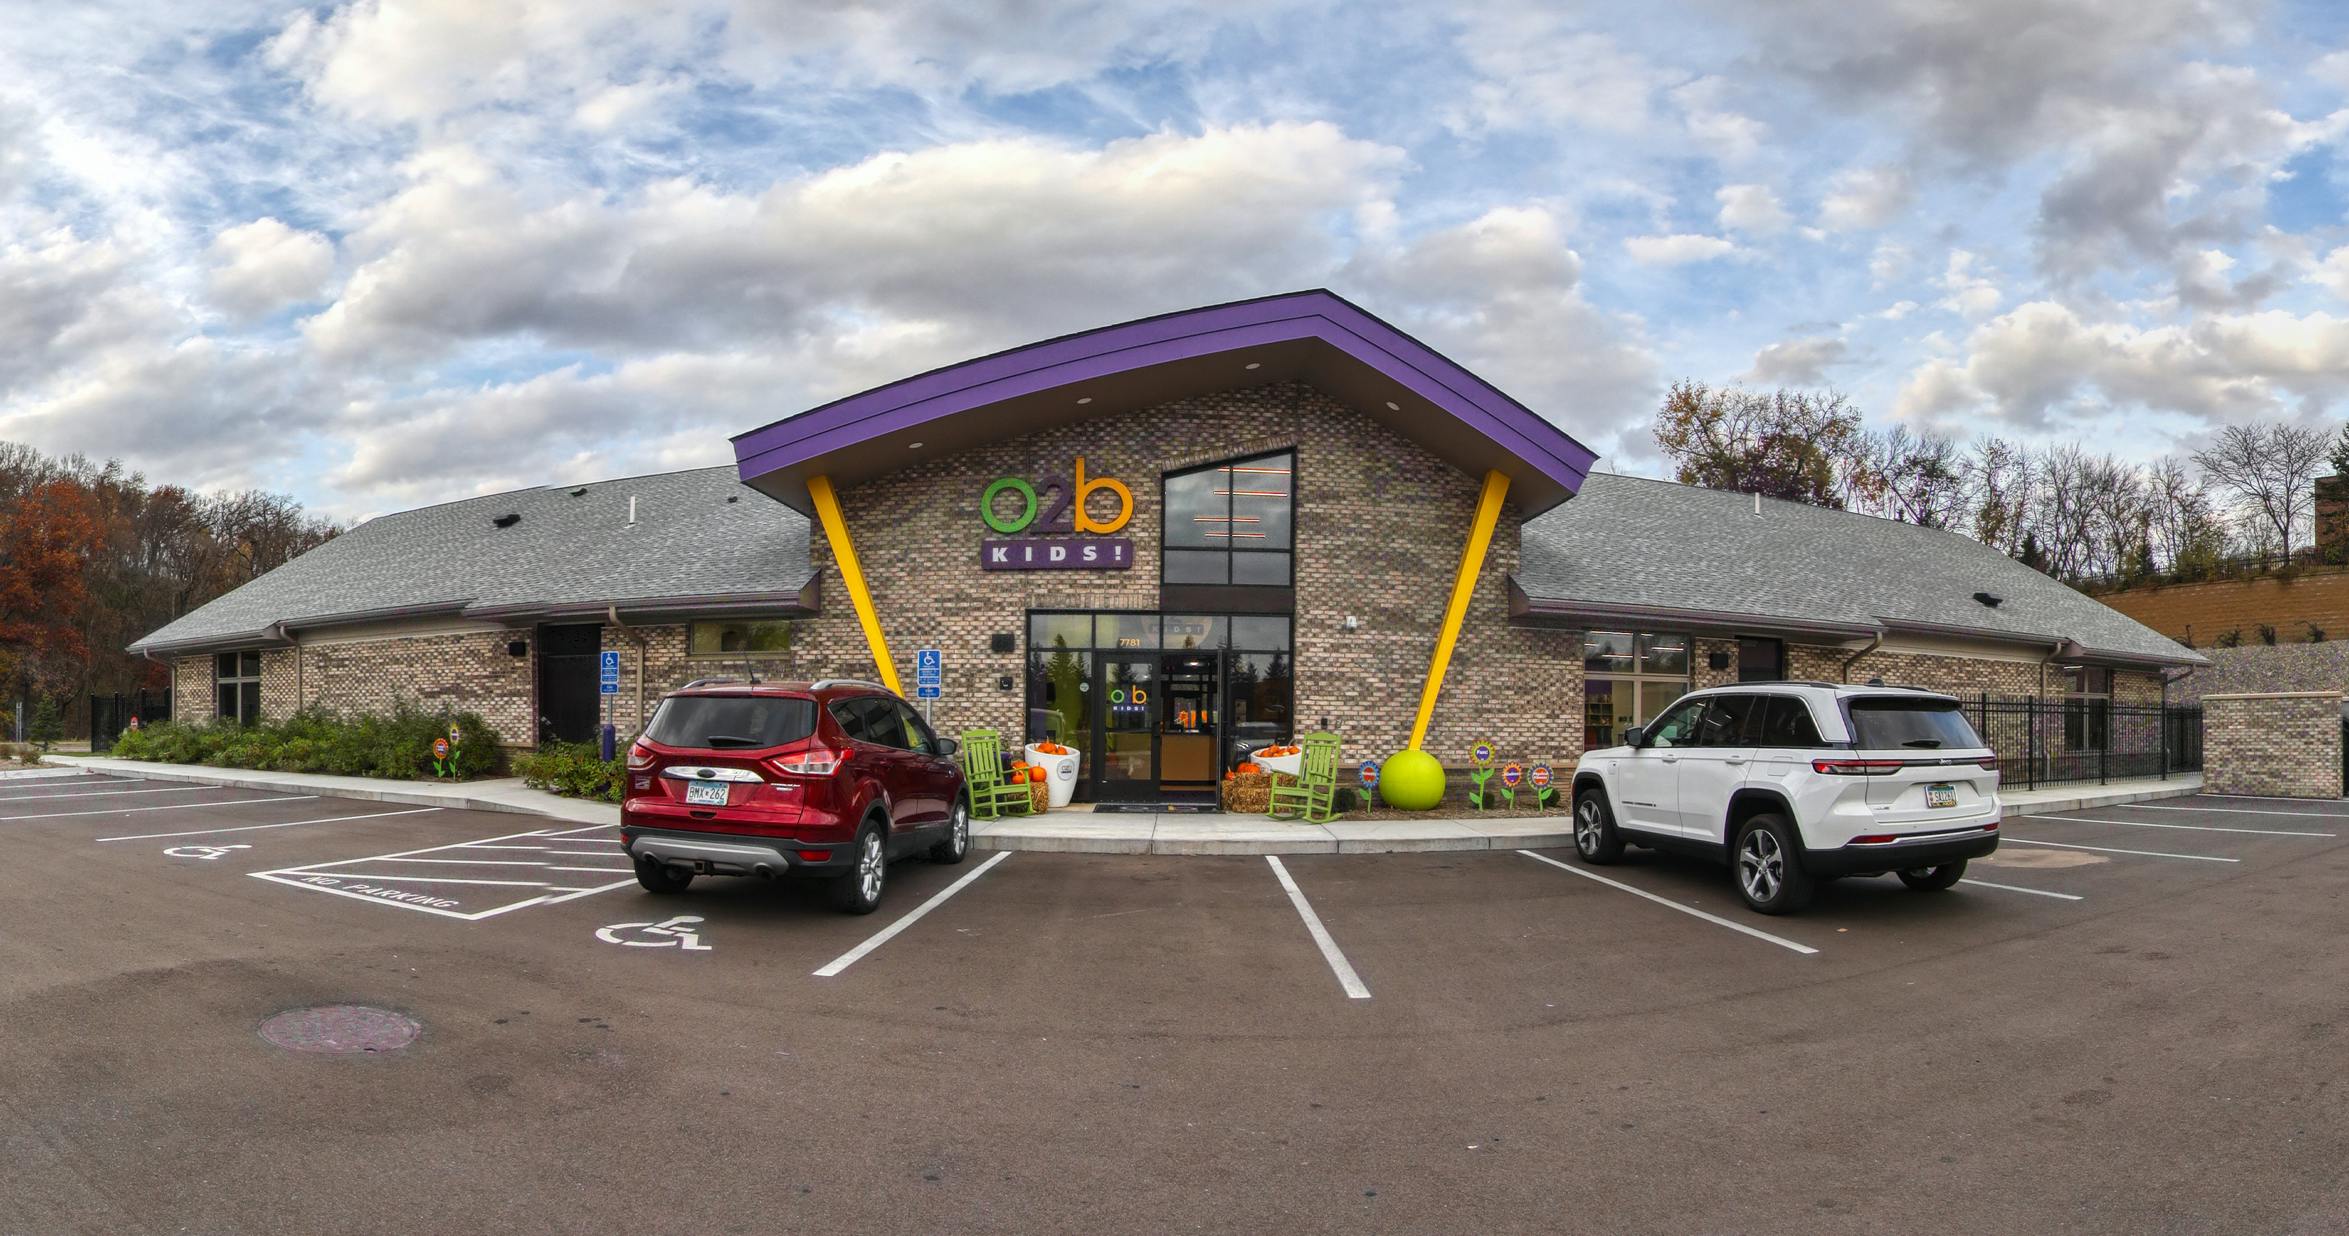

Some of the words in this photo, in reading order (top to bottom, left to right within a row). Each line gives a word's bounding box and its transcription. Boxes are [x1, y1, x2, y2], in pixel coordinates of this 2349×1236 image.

[981, 456, 1134, 534] o2b
[992, 546, 1122, 562] KIDS!
[1120, 638, 1140, 647] 7781
[709, 788, 726, 800] 262
[300, 876, 341, 885] NO
[343, 884, 459, 908] PARKING
